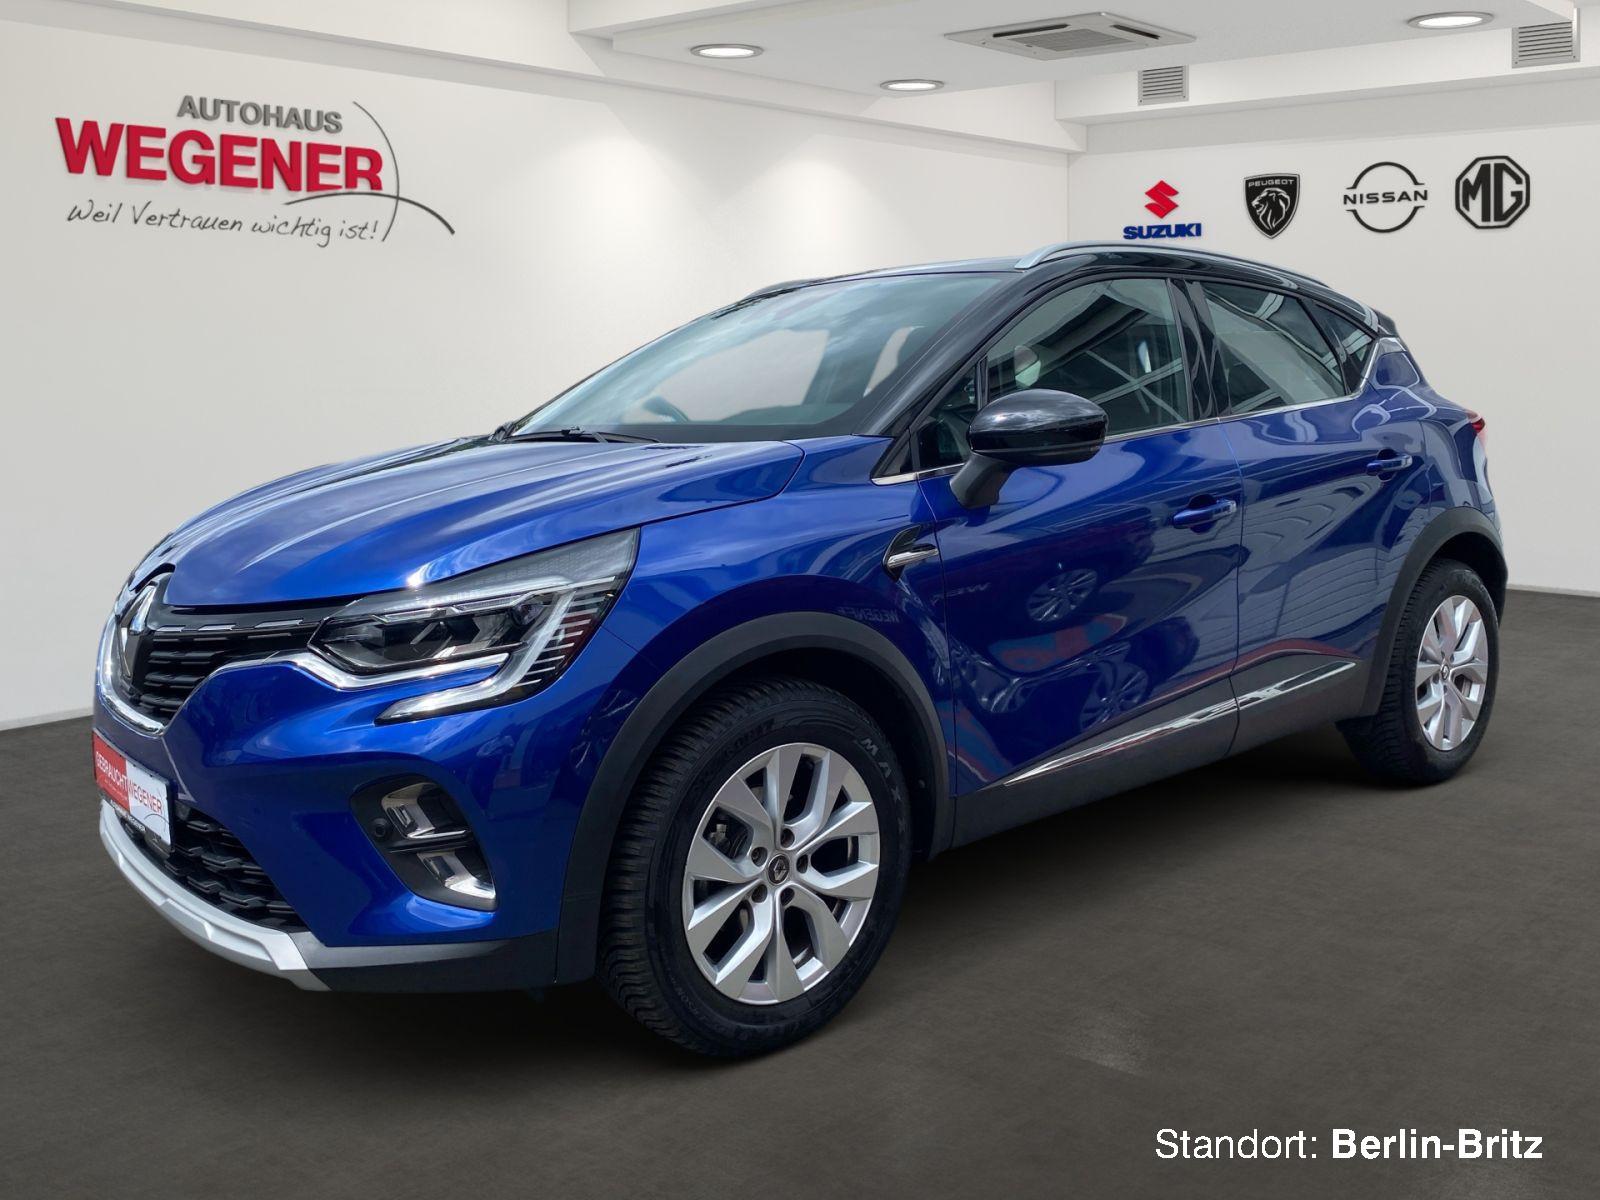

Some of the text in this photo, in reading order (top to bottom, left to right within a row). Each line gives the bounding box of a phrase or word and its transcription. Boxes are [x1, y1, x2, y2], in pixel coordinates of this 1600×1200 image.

[177, 95, 343, 134] AUTOHAUS
[55, 117, 384, 193] WEGENER
[1248, 178, 1295, 188] PEUGEOT
[1343, 189, 1429, 206] NISSAN
[1460, 162, 1525, 223] MG
[67, 199, 378, 248] Weil Vertrauen wichtig ist!
[1123, 222, 1203, 240] SUZUKI
[128, 778, 163, 815] WEGENER
